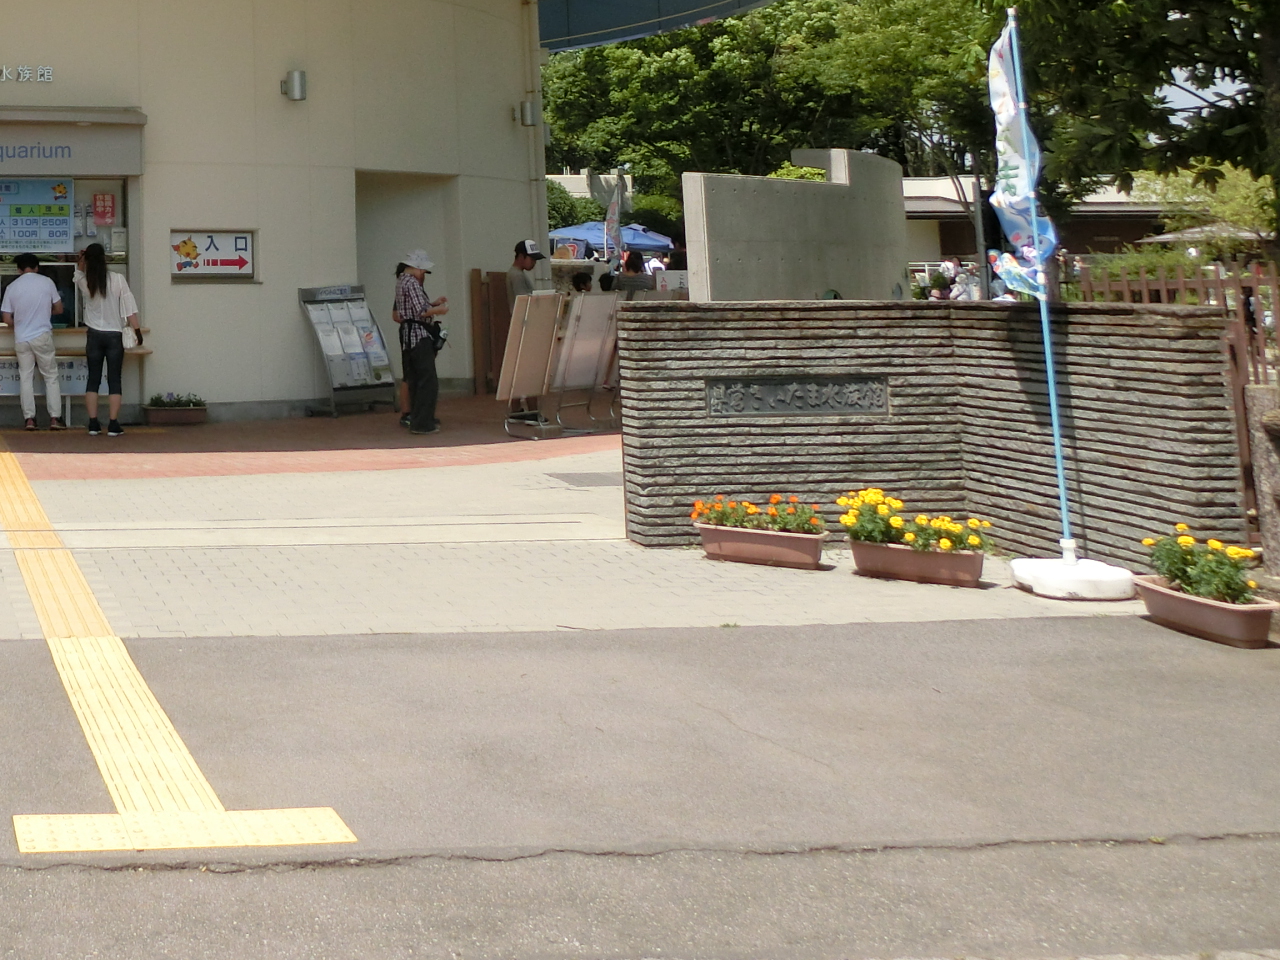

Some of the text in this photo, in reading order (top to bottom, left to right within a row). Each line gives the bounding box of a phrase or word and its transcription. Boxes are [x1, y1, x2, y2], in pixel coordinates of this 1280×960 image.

[11, 218, 38, 226] 310円
[41, 218, 68, 226] 250円
[12, 230, 38, 238] 100円
[48, 230, 68, 238] 80円
[205, 235, 249, 252] 入口
